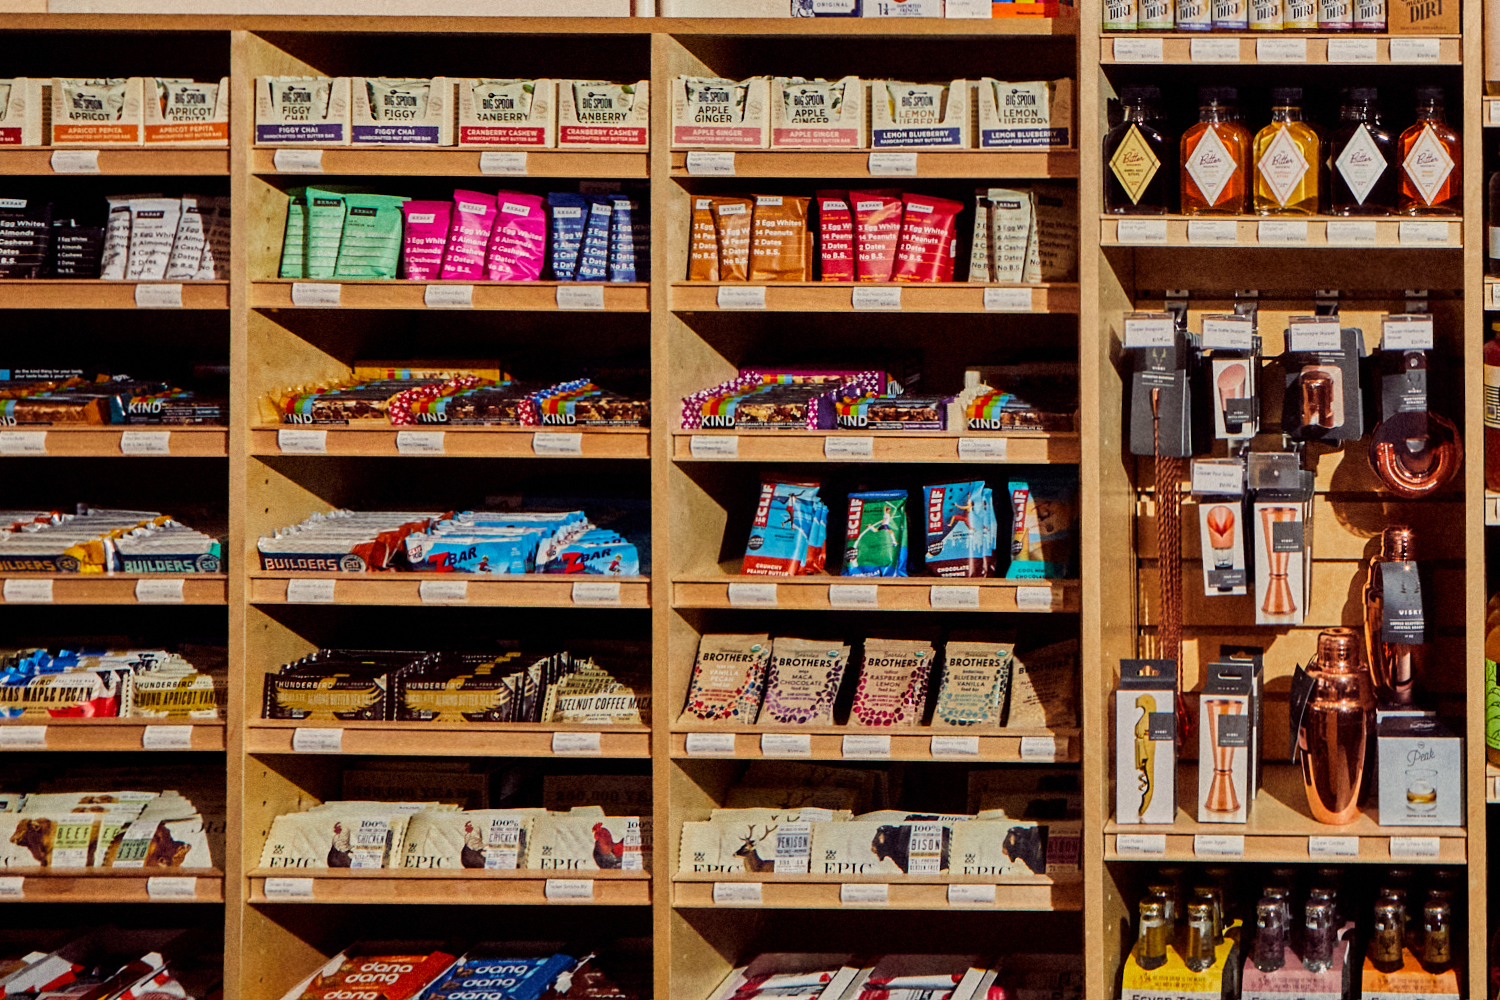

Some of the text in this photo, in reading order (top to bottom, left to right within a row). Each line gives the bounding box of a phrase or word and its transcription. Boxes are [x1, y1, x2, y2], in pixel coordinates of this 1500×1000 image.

[1016, 95, 1036, 106] SPOON
[168, 107, 212, 116] APRICOT
[282, 106, 312, 115] FIGGY
[384, 109, 417, 118] FIGGY
[697, 106, 729, 114] APPLE
[794, 109, 825, 117] APPLE
[1003, 109, 1038, 117] LEMON
[694, 114, 733, 123] GINGER
[508, 129, 538, 137] CASHEW
[609, 129, 639, 137] CASHEW
[716, 129, 742, 137] GINGER
[883, 130, 949, 139] LEMON BLUEBERRY
[762, 220, 775, 228] Egg
[128, 402, 161, 414] KIND
[542, 414, 577, 426] KIND
[701, 415, 734, 428] KIND
[967, 417, 1001, 429] KIND
[758, 484, 775, 515] CLIF
[930, 488, 944, 520] CLIF
[124, 559, 195, 573] BUILDERS
[264, 557, 338, 571] BUILDERS
[755, 563, 783, 571] CRUNCHY
[703, 653, 754, 662] BROTHERS
[779, 658, 832, 667] BROTHERS
[867, 658, 918, 667] BROTHERS
[949, 658, 1001, 667] BROTHERS
[135, 681, 193, 690] THUNDERBIRD
[275, 681, 333, 690] THUNDERBIRD
[406, 681, 464, 690] THUNDERBIRD
[22, 687, 94, 702] MAPLE PECAN
[164, 692, 198, 706] APRICOT
[595, 696, 629, 710] COFFEE
[1407, 749, 1436, 767] Peak
[57, 826, 90, 839] BEEF
[777, 836, 809, 849] VENISON
[911, 838, 941, 851] BISON
[475, 965, 528, 976] dang
[344, 972, 399, 985] dang
[462, 977, 516, 989] dang
